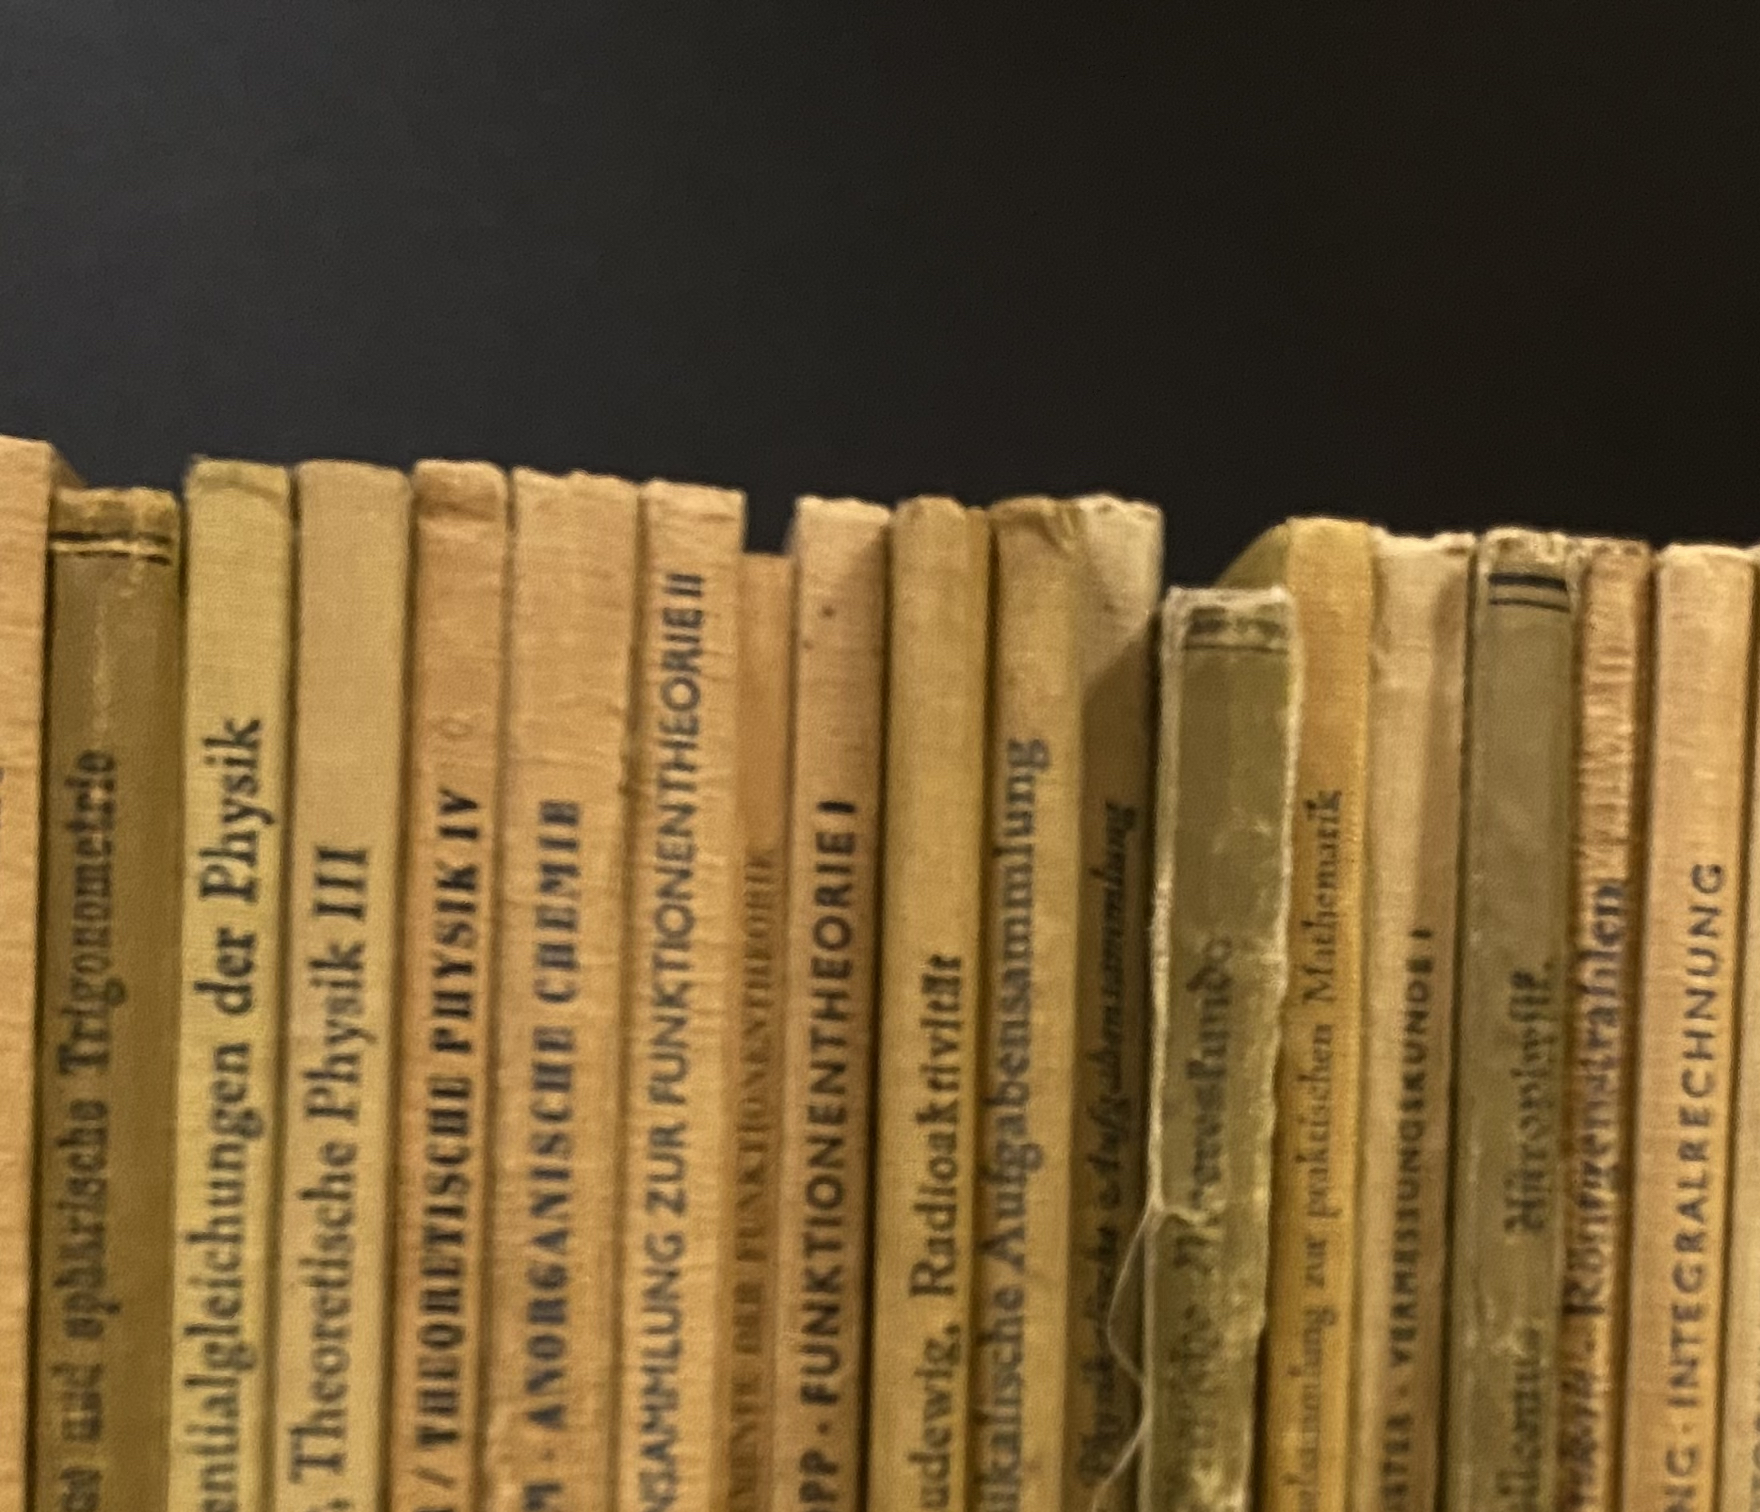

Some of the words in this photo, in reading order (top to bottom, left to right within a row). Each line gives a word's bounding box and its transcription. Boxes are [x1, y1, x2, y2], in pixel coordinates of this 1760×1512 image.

[54, 748, 127, 1077] Trigonometrie
[199, 717, 273, 905] Physik
[312, 844, 369, 923] III
[433, 787, 482, 840] IV
[532, 799, 583, 1003] CHEMIE
[648, 609, 705, 1104] FUNKTIONENTHEORIE
[1300, 791, 1343, 1004] Mathematik
[193, 930, 257, 1016] der
[302, 940, 376, 1123] Physik
[425, 863, 479, 1054] PHYSIK
[977, 739, 1049, 1268] Aufgabensammlung
[646, 1123, 688, 1216] ZUR
[796, 831, 857, 1407] FUNKTIONENTHEORIE
[907, 954, 963, 1298] Radioaktivität
[1298, 1025, 1341, 1218] praktischen
[1667, 863, 1724, 1408] INTEGRALRECHNUNG
[288, 1144, 357, 1482] Theoretische
[412, 1077, 473, 1450] THEORETISCHE
[525, 1026, 576, 1430] ANORGANISCHE
